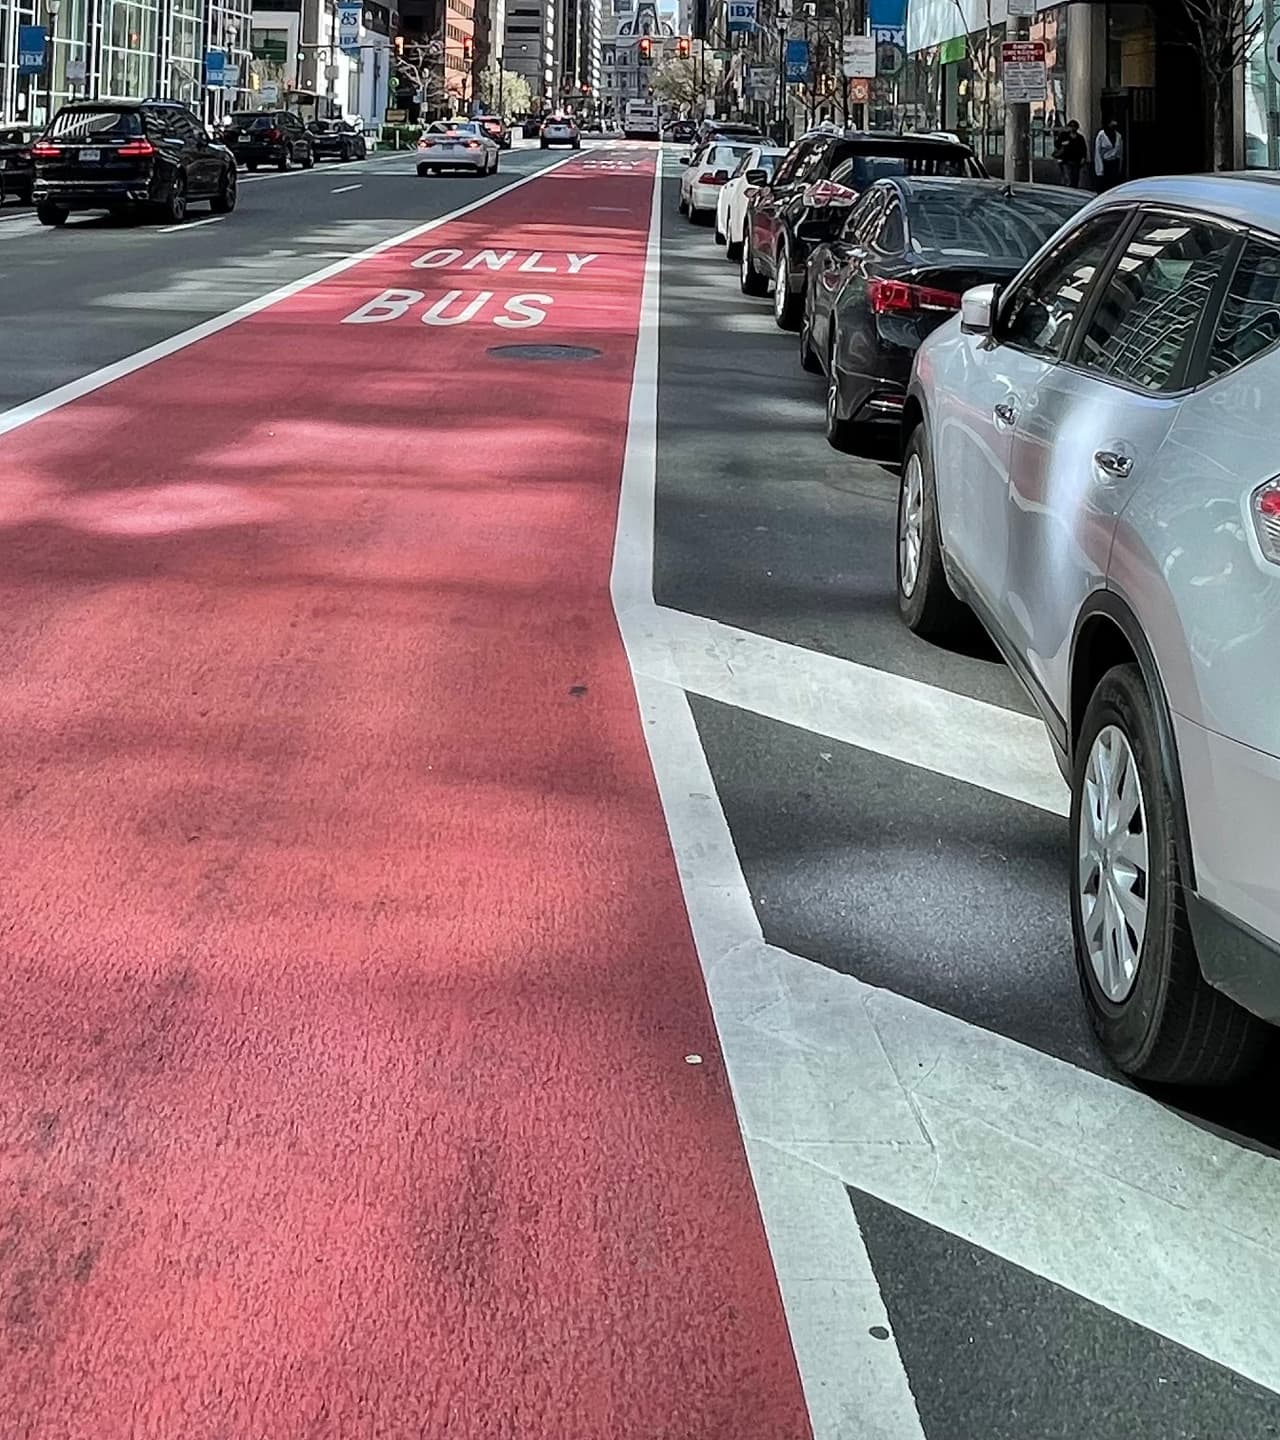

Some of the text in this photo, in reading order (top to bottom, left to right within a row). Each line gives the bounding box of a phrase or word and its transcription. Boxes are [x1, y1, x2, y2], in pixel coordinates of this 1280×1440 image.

[340, 11, 358, 26] 85
[730, 5, 754, 18] IBX
[411, 248, 599, 274] ONLY
[340, 288, 555, 329] BUS
